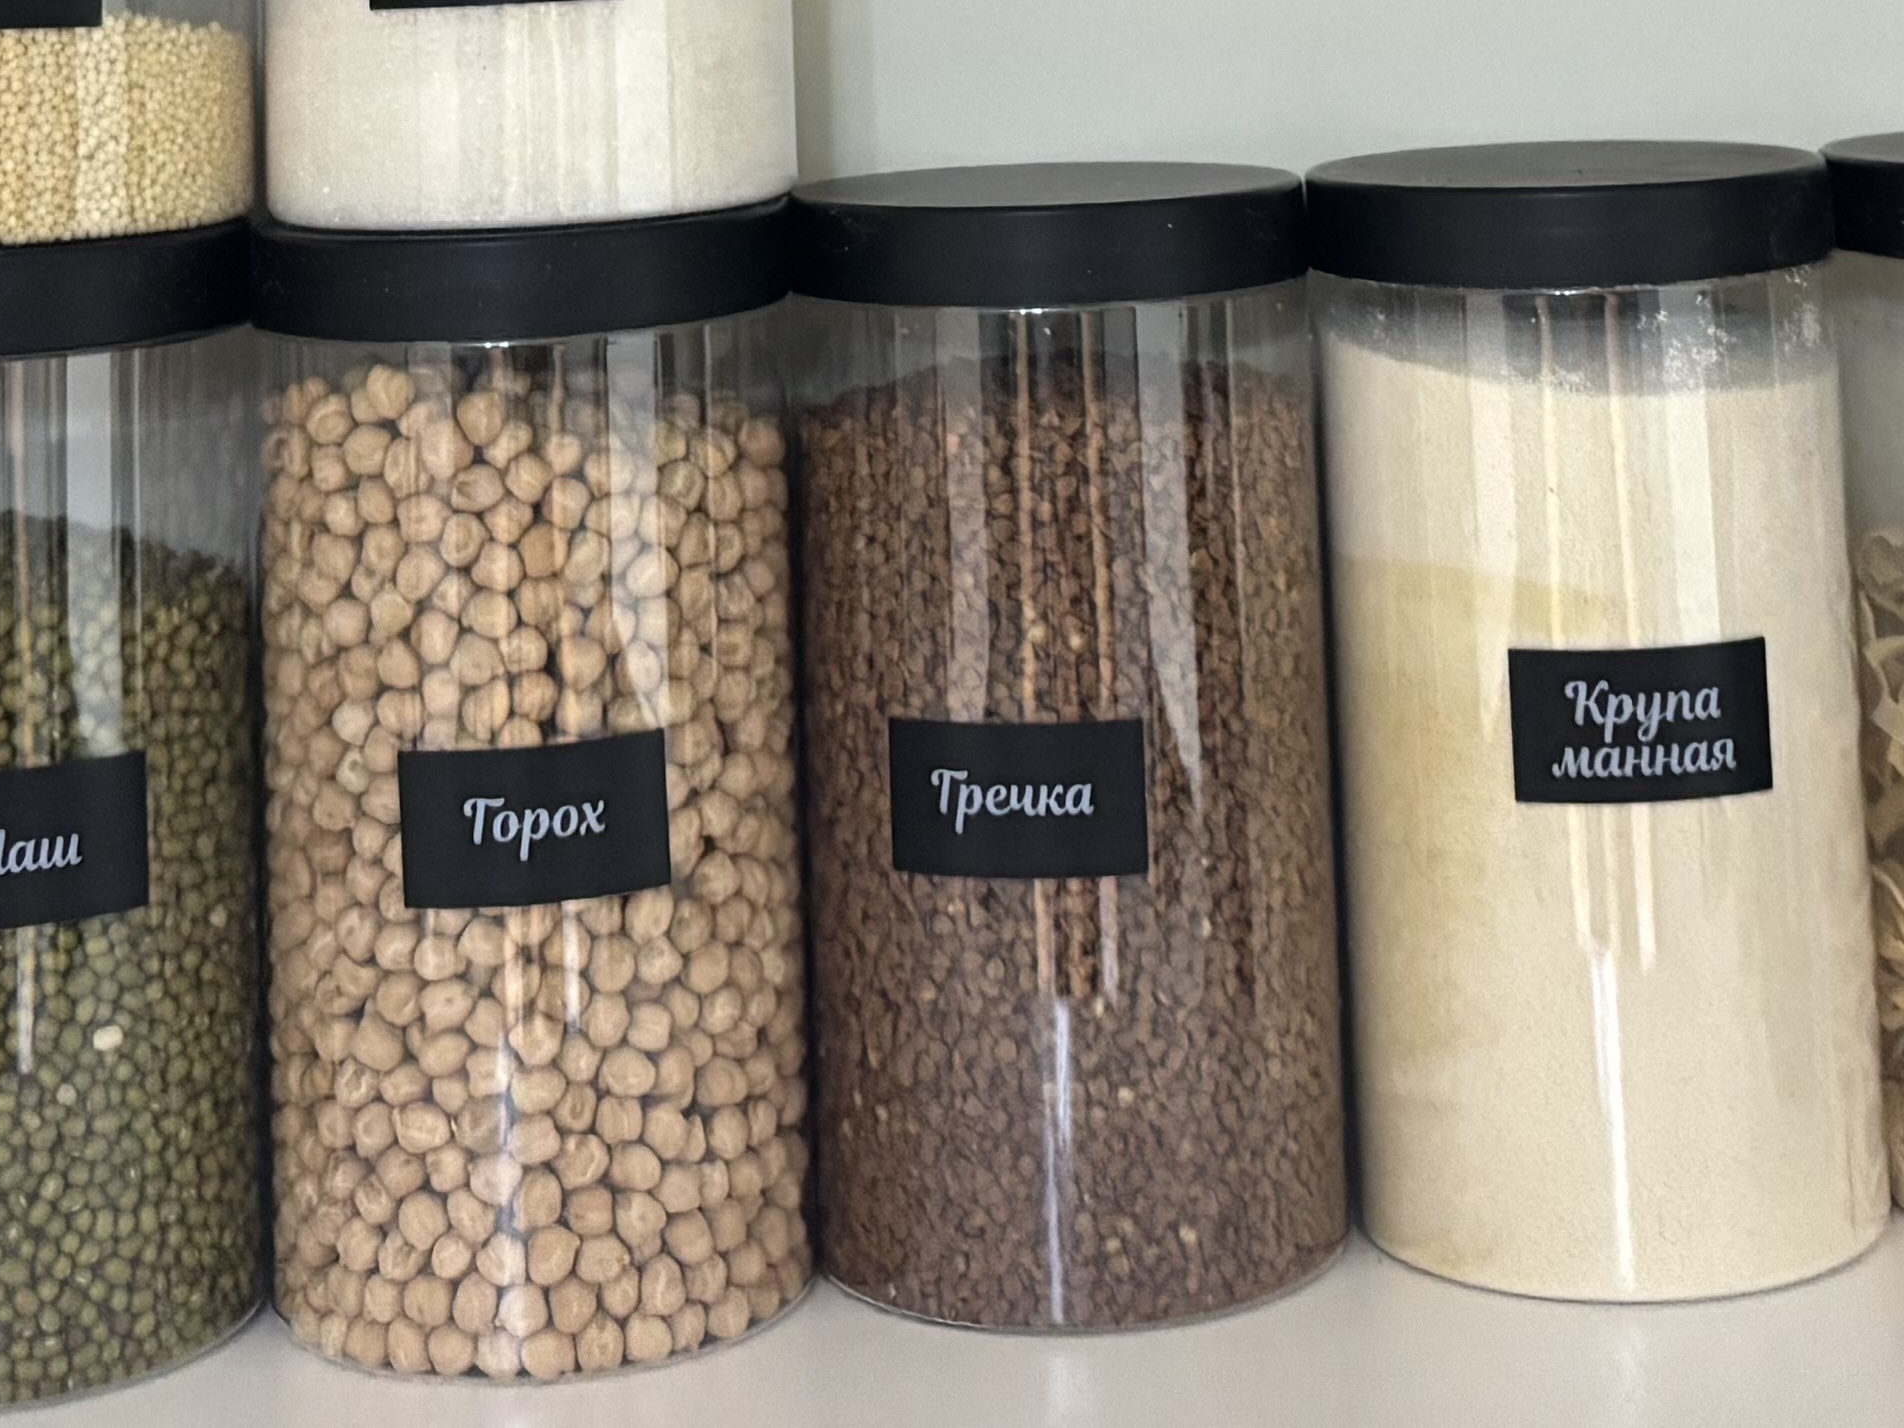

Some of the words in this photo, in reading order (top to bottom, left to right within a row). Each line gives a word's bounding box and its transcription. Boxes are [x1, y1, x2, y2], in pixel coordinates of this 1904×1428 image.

[1564, 680, 1722, 743] Крупа
[1552, 738, 1736, 779] манная
[463, 797, 606, 862] Горох
[930, 768, 1095, 835] Гречка
